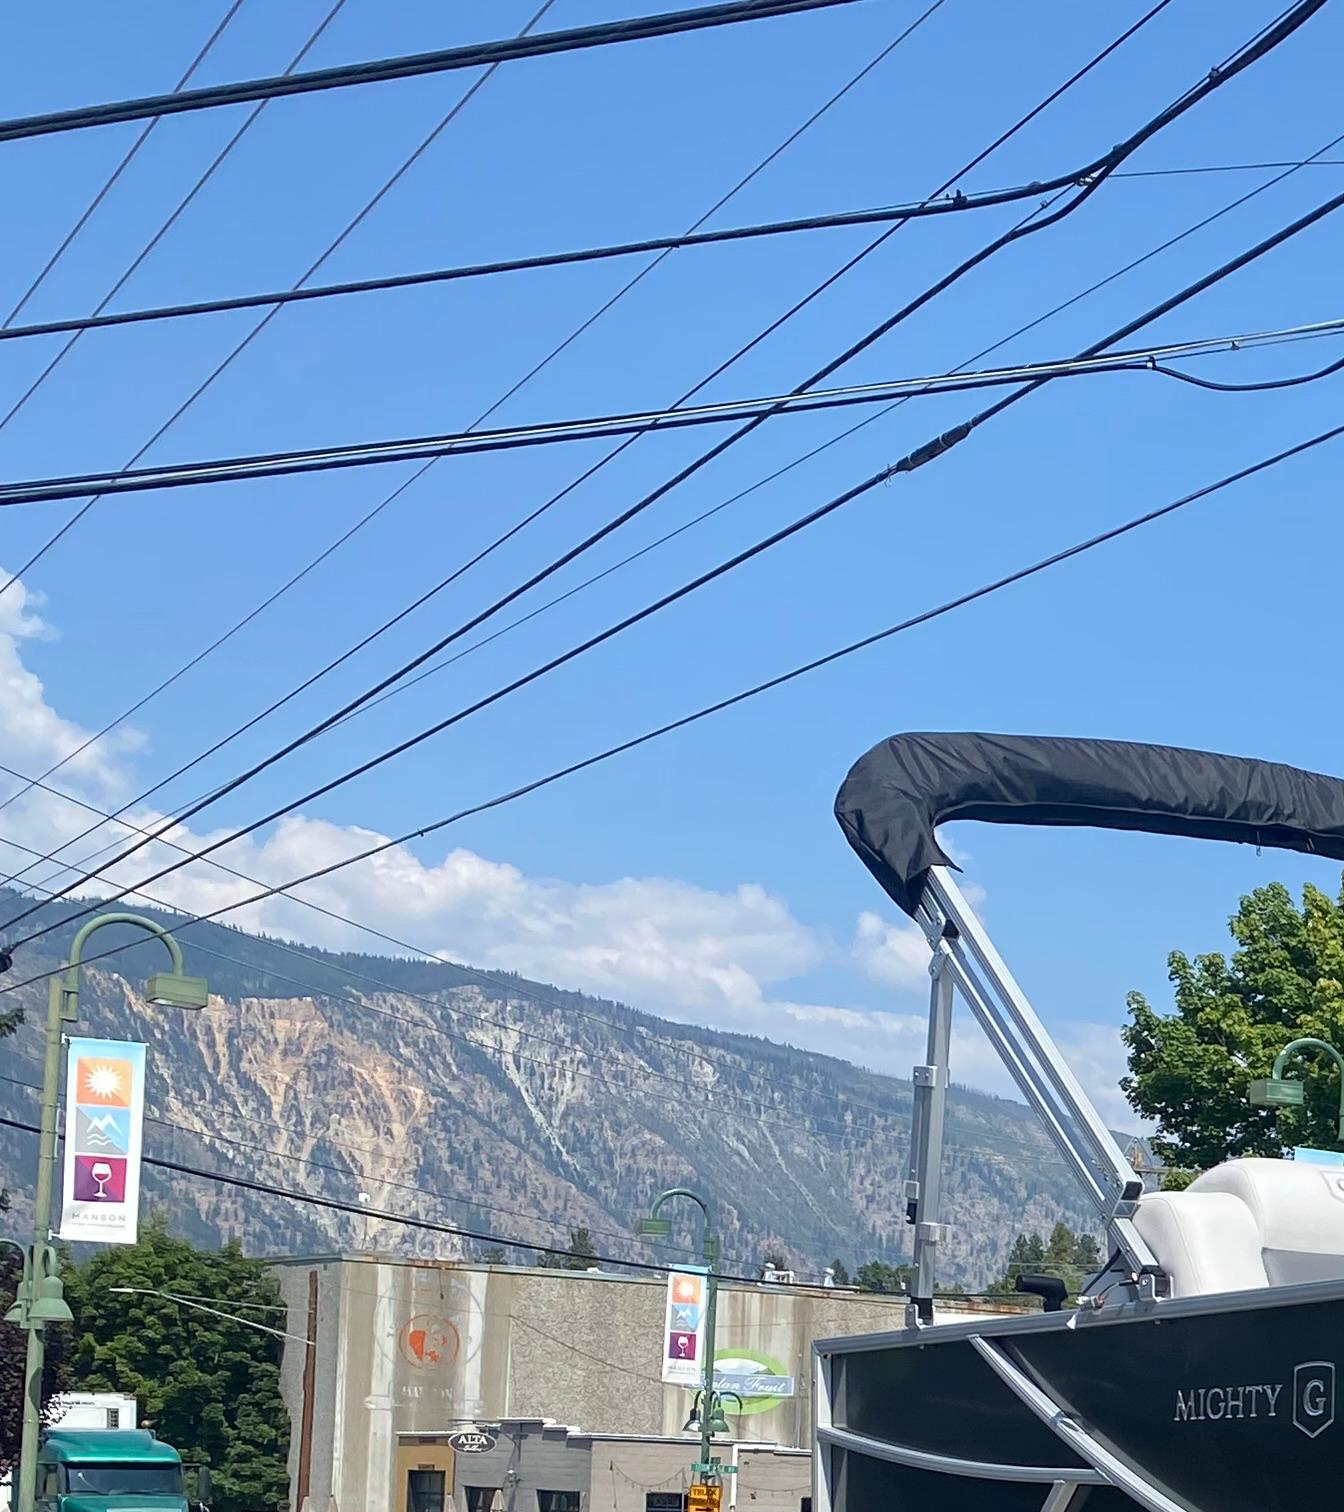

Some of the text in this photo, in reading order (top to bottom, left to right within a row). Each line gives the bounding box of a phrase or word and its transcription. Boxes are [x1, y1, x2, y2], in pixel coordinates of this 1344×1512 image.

[1173, 1378, 1327, 1422] MIGHTY G
[458, 1434, 488, 1445] ALTA
